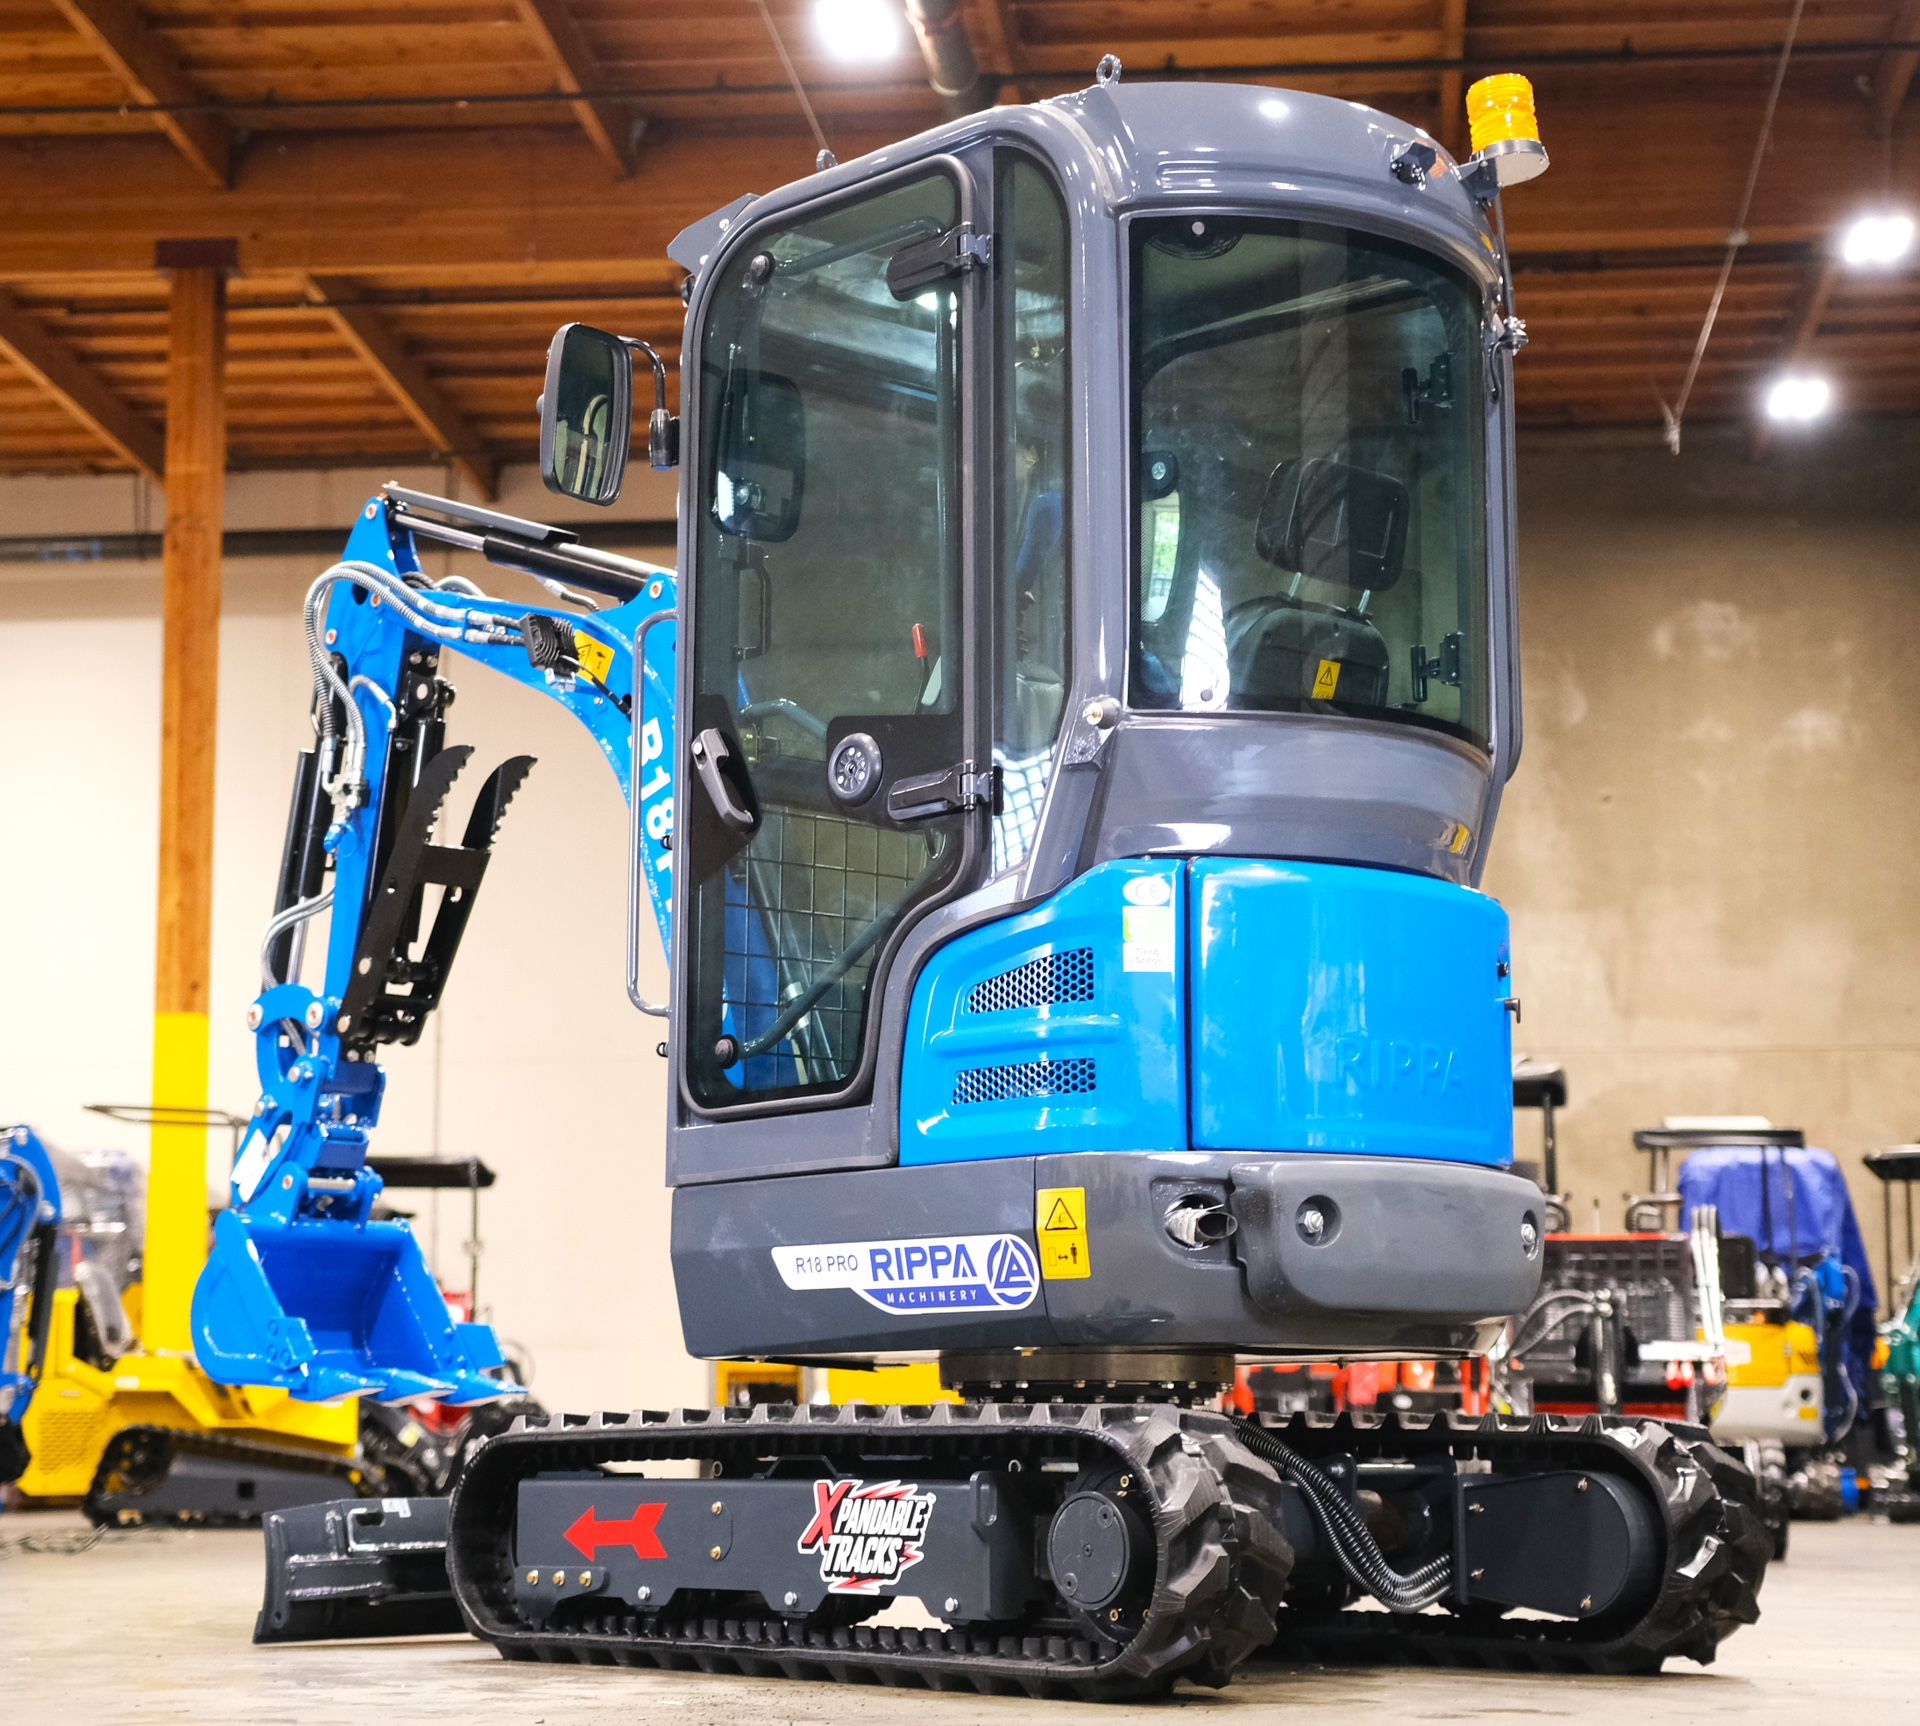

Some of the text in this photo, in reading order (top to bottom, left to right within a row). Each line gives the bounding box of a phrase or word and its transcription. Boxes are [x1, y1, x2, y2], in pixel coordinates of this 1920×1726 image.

[1336, 1037, 1467, 1098] RIPPA
[795, 1254, 859, 1274] R18 PRO
[869, 1244, 978, 1282] RIPPA
[886, 1289, 979, 1304] MACHINERY
[802, 1482, 928, 1546] XPANDABLE
[824, 1535, 904, 1575] TRACKS
